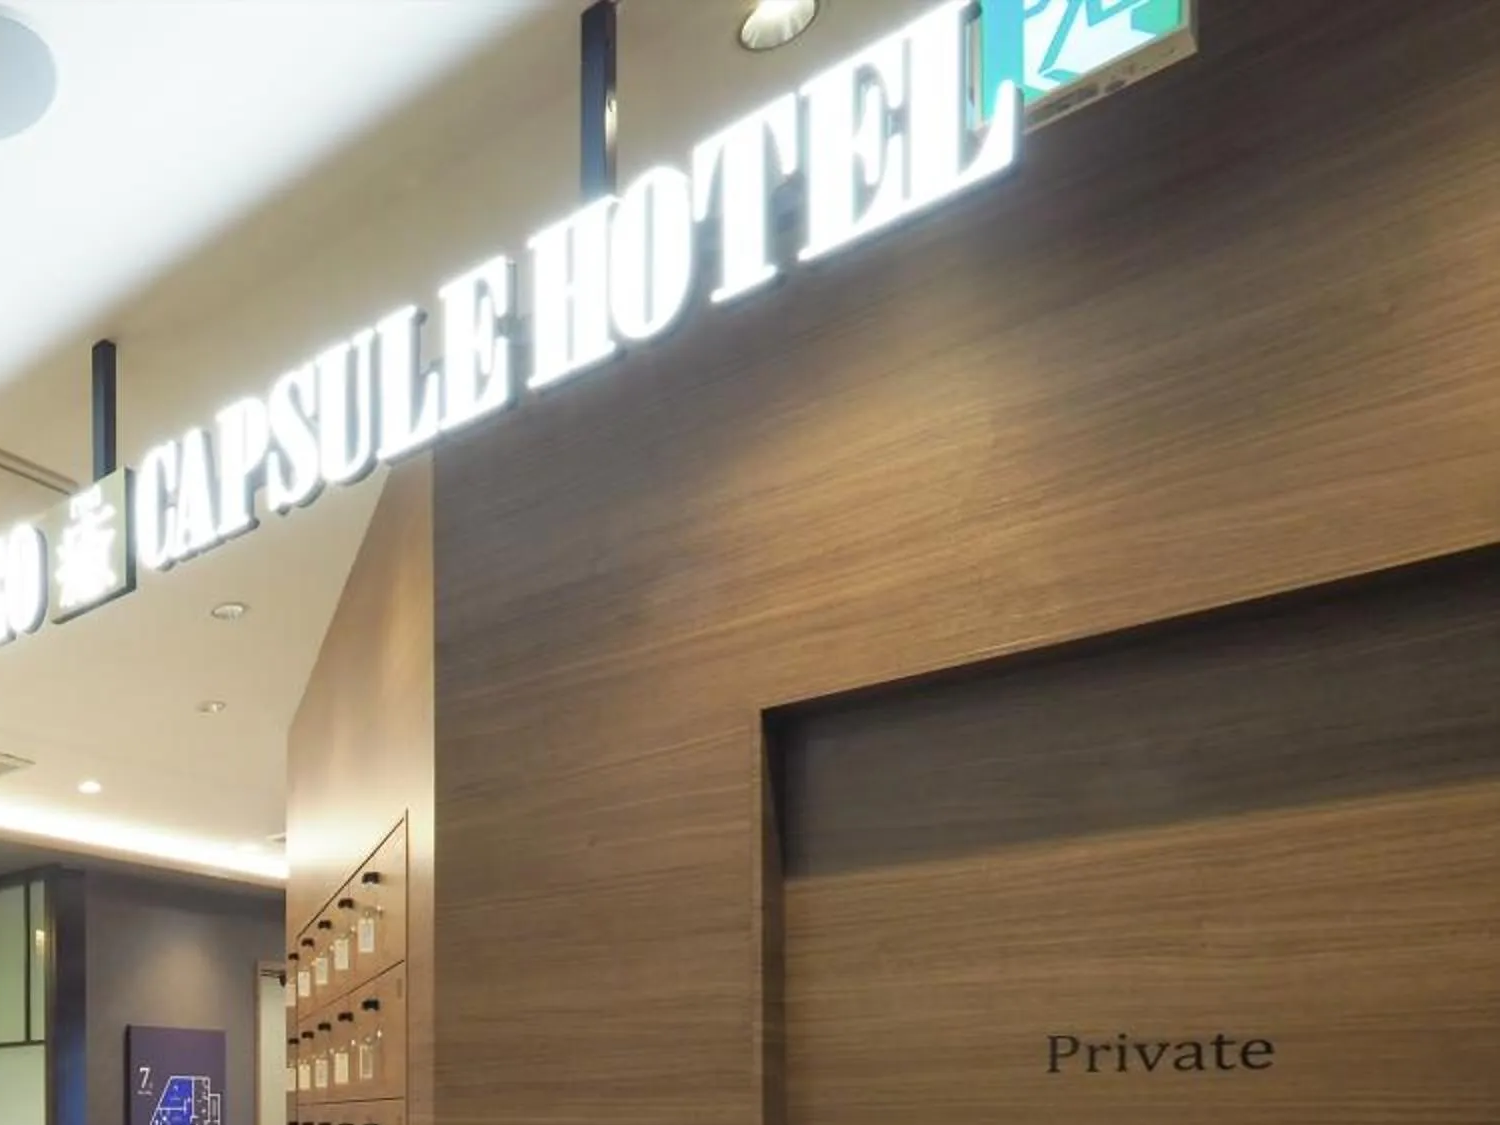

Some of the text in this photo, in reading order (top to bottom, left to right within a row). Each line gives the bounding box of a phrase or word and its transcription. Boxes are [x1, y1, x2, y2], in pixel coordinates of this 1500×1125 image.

[135, 256, 514, 570] CAPSULE
[528, 0, 1022, 389] HOTEL
[1046, 1032, 1275, 1074] Private
